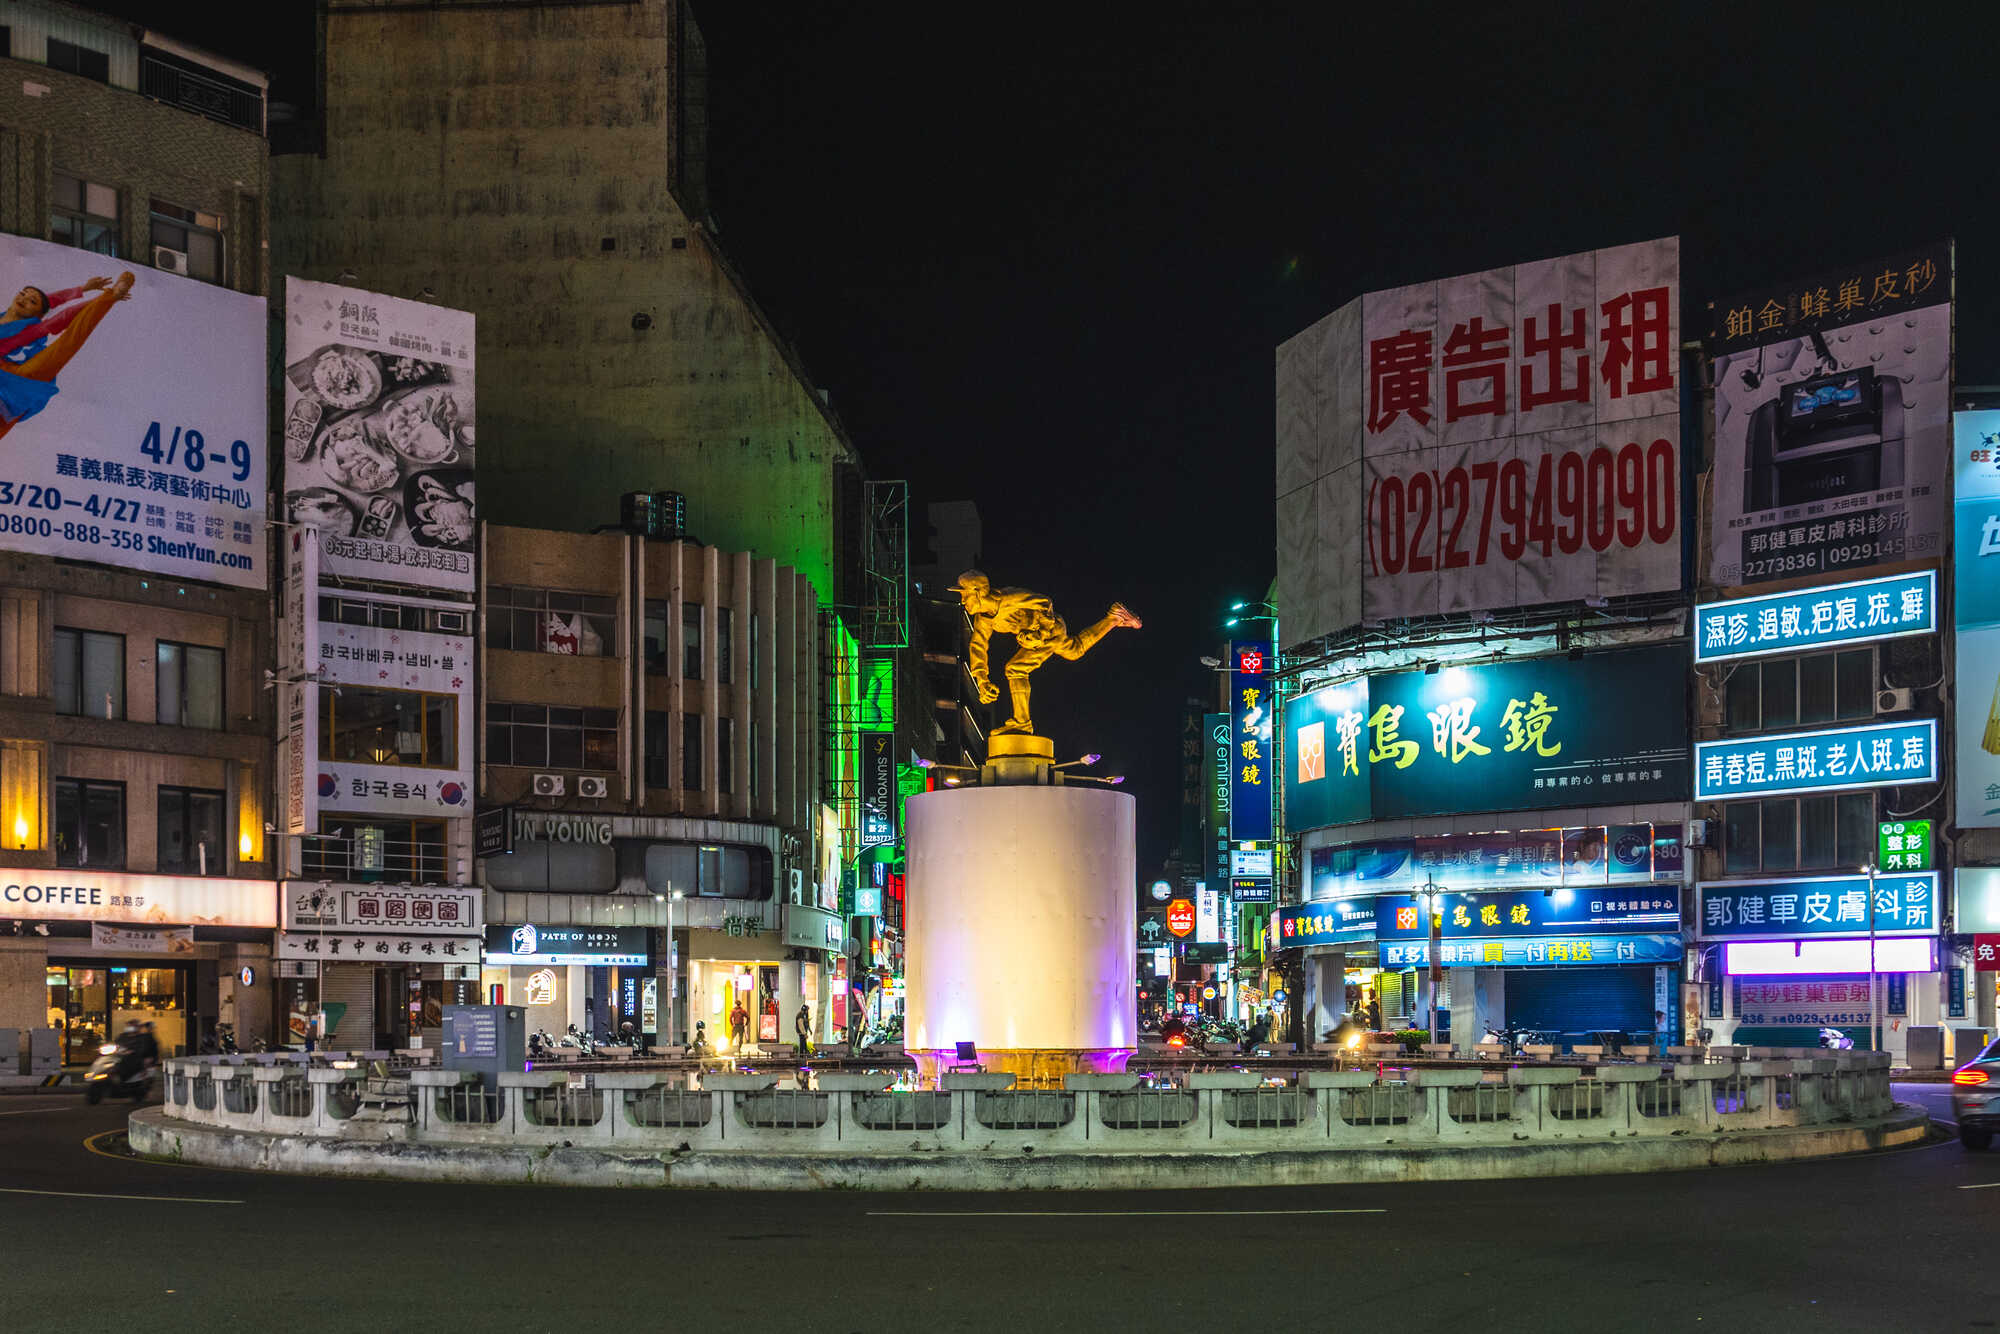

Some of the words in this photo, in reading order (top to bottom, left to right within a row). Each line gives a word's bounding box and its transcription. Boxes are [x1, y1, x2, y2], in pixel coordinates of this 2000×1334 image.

[1724, 300, 1785, 340] 鉑金
[1800, 259, 1937, 320] 蜂巢皮秒
[1367, 286, 1674, 434] 廣告出租
[141, 421, 250, 481] 4/8-9
[57, 453, 251, 509] 嘉義縣表演藝術中心
[146, 517, 165, 529] 台南
[176, 510, 195, 523] 台北
[205, 516, 224, 527] 台中
[1368, 439, 1675, 577] (02)27949090
[0, 514, 143, 550] 0800-888-358
[148, 535, 252, 569] ShenYun.com
[1750, 512, 1909, 553] 郭健軍皮膚科診所
[1241, 688, 1261, 785] 寶島眼鏡
[1335, 692, 1562, 777] 寶島眼鏡
[352, 778, 426, 800] 한국음식
[878, 758, 887, 820] SUNYOUNG
[1216, 747, 1230, 813] eminent
[1534, 776, 1593, 789] 用專業的心
[545, 821, 612, 845] YOUNG
[1887, 834, 1922, 850] 整形
[1888, 853, 1921, 870] 外科
[5, 884, 101, 905] COFFEE
[1706, 889, 1902, 926] 郭健軍皮膚科
[1906, 881, 1928, 925] 診所
[541, 933, 567, 941] PATH
[572, 933, 584, 941] OF
